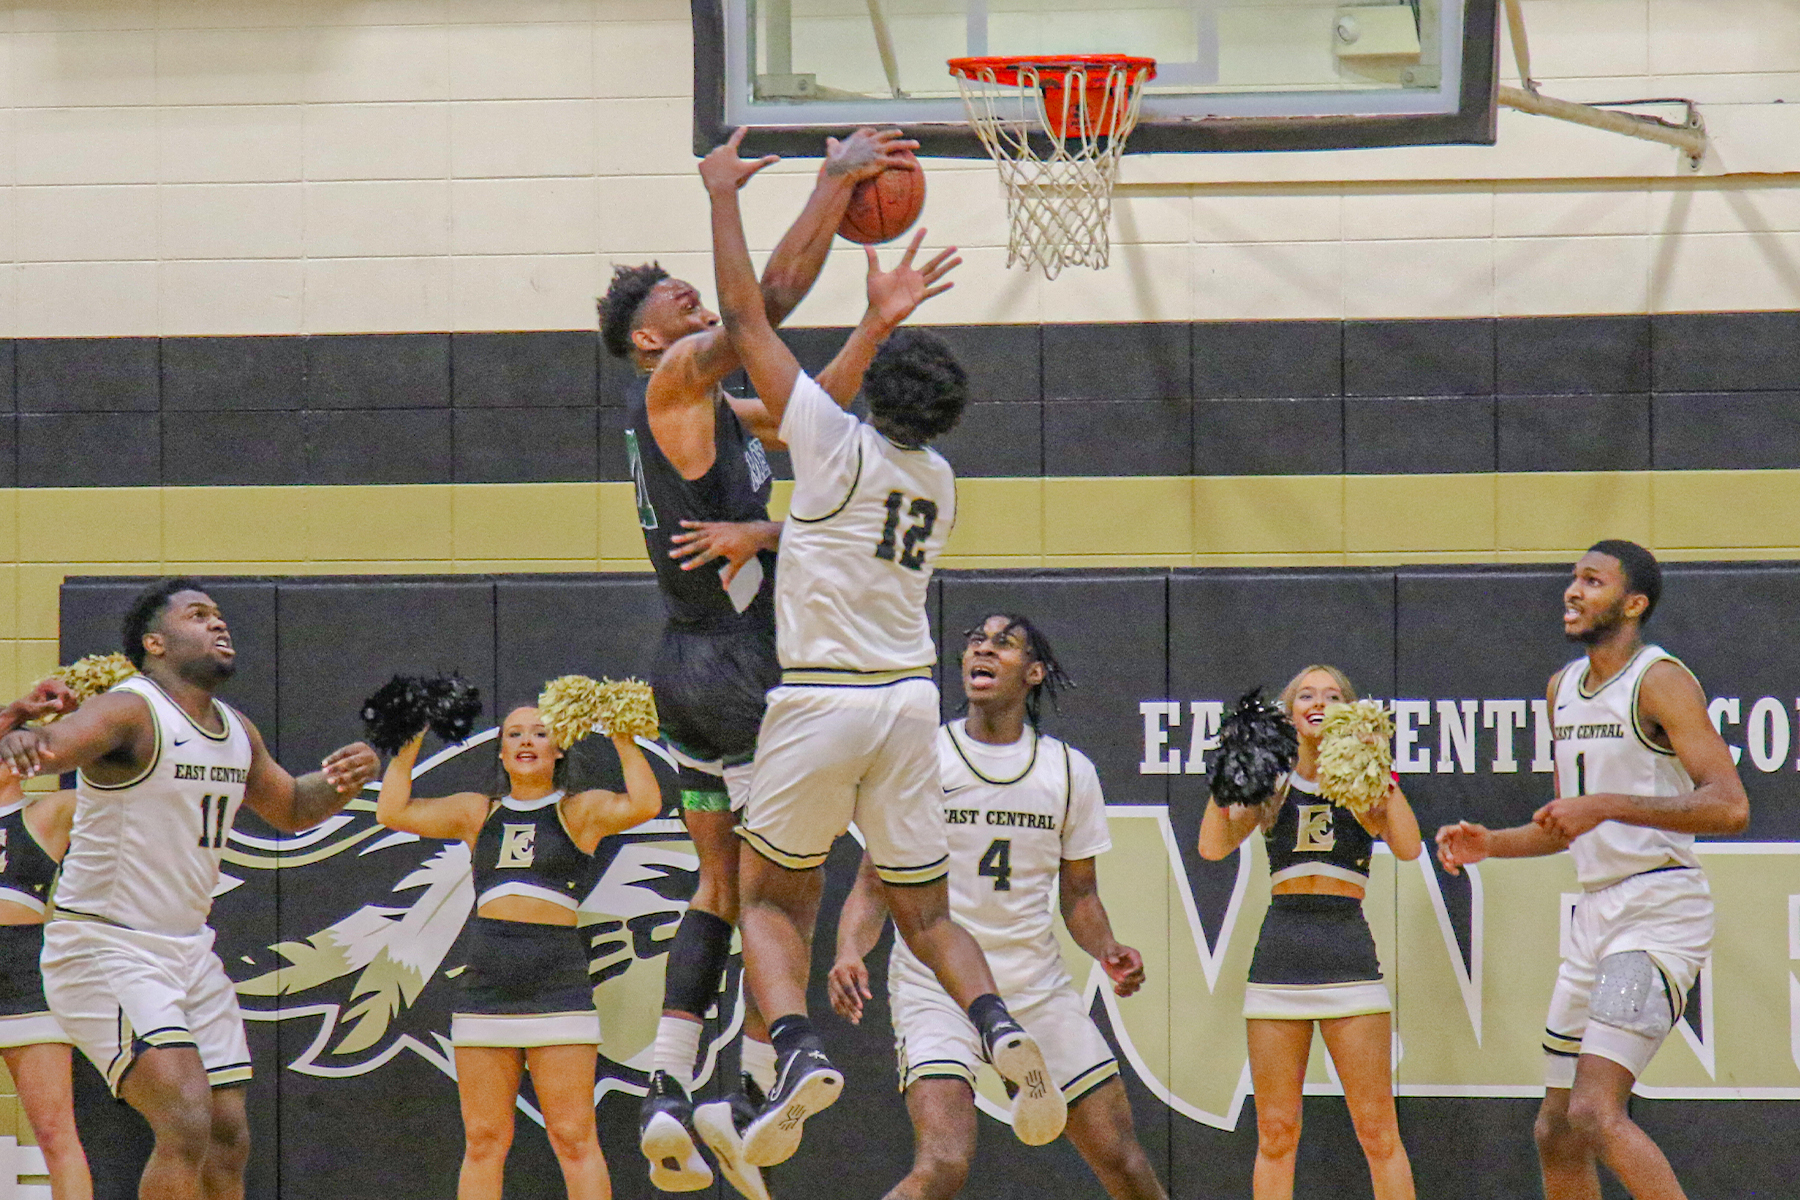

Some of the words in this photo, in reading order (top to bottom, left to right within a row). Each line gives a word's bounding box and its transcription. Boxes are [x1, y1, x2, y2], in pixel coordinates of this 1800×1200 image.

[875, 491, 938, 571] 12
[1140, 700, 1224, 775] EA
[1706, 695, 1800, 774] CO
[1577, 723, 1625, 739] CENTRAL
[174, 764, 206, 781] EAST
[1575, 750, 1586, 796] 1
[198, 792, 229, 848] 11
[985, 810, 1056, 830] CENTRAL
[978, 837, 1012, 892] 4
